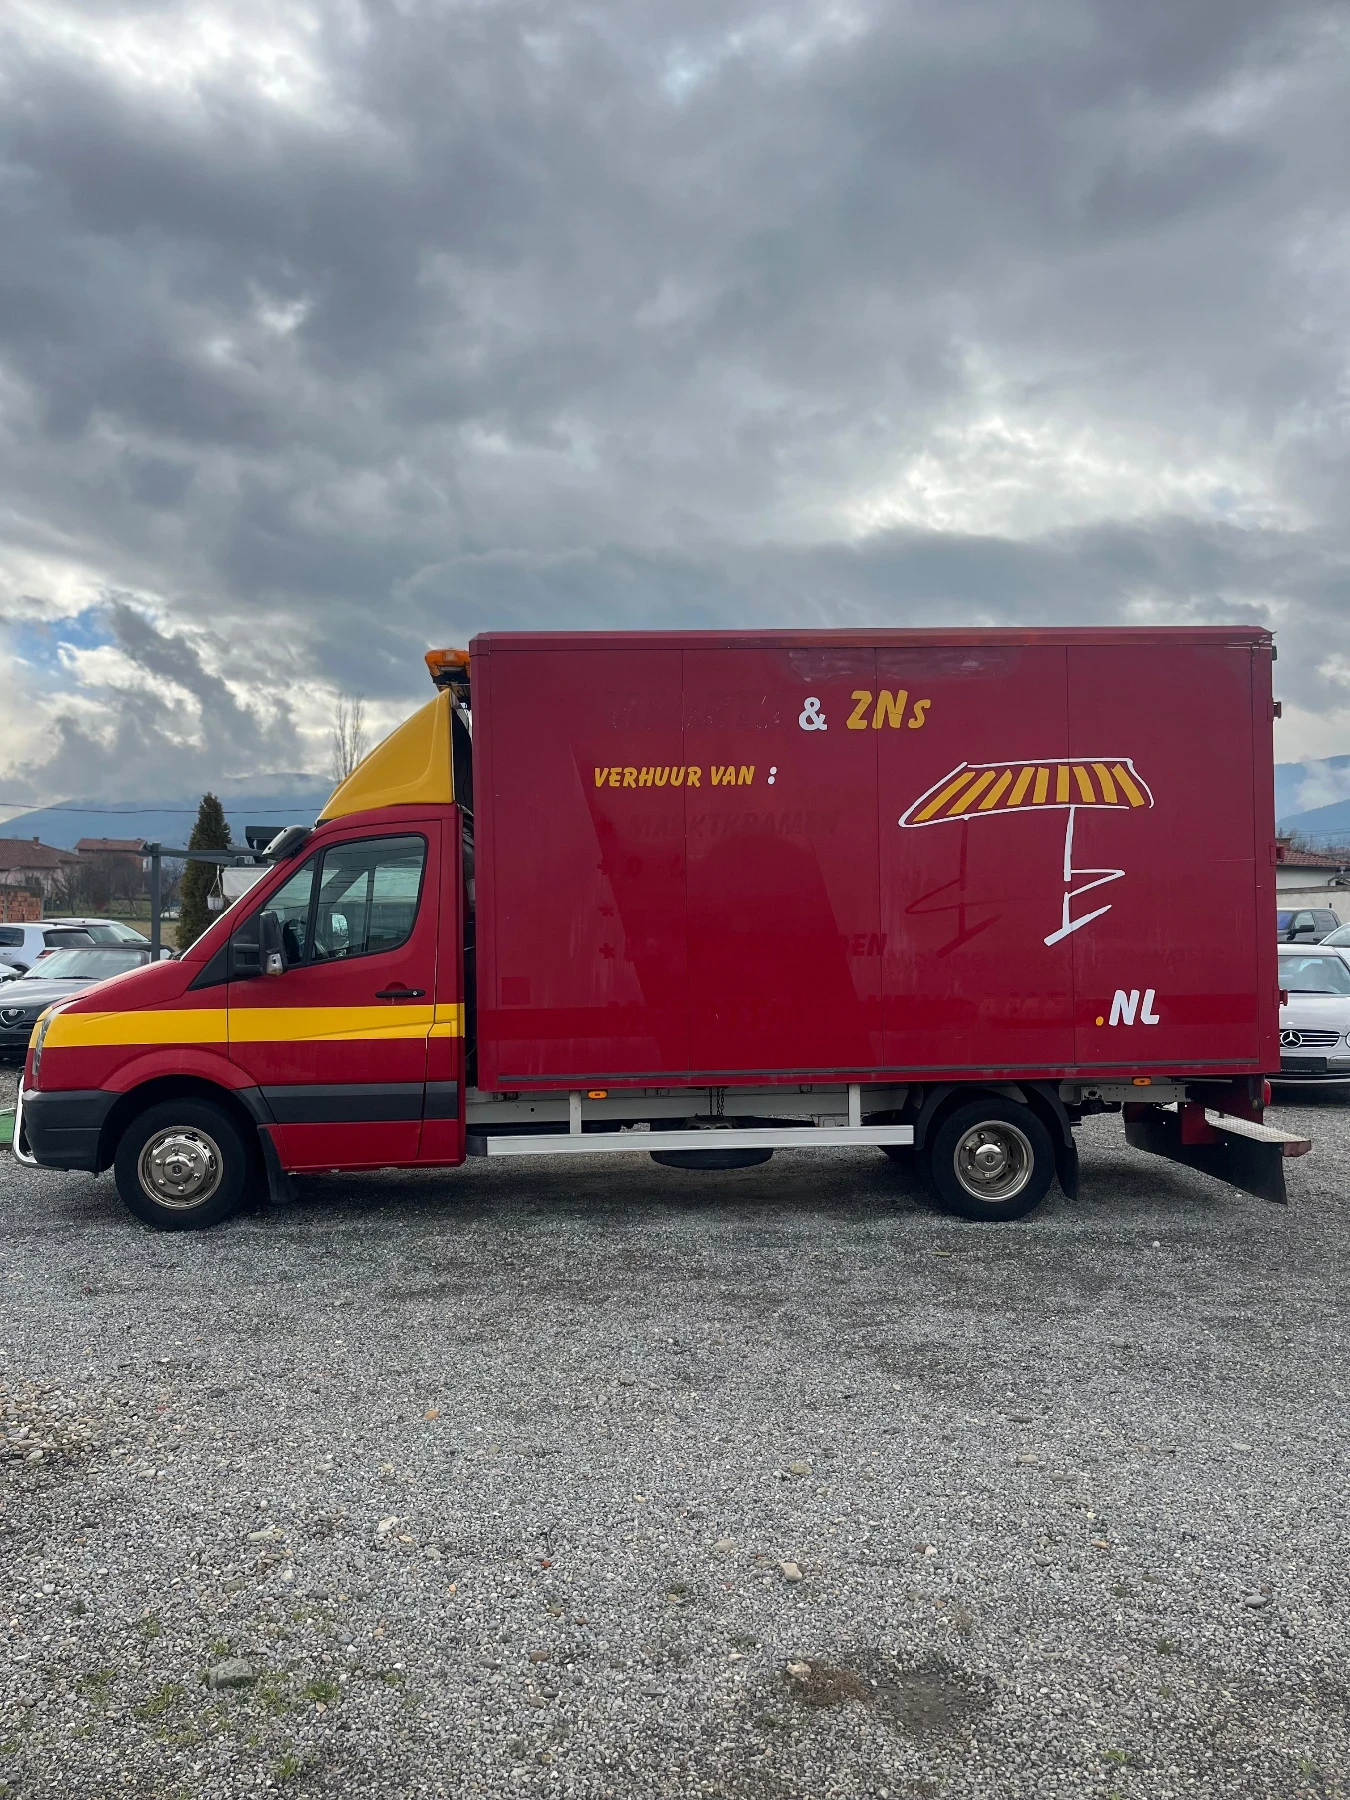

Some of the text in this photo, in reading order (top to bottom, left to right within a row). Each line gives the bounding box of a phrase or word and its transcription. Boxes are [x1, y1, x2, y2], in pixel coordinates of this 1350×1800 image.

[799, 697, 828, 731] &
[846, 689, 932, 730] ZNs
[594, 766, 702, 788] VERHUUR
[710, 765, 755, 786] VAN
[1095, 989, 1160, 1027] .NL
